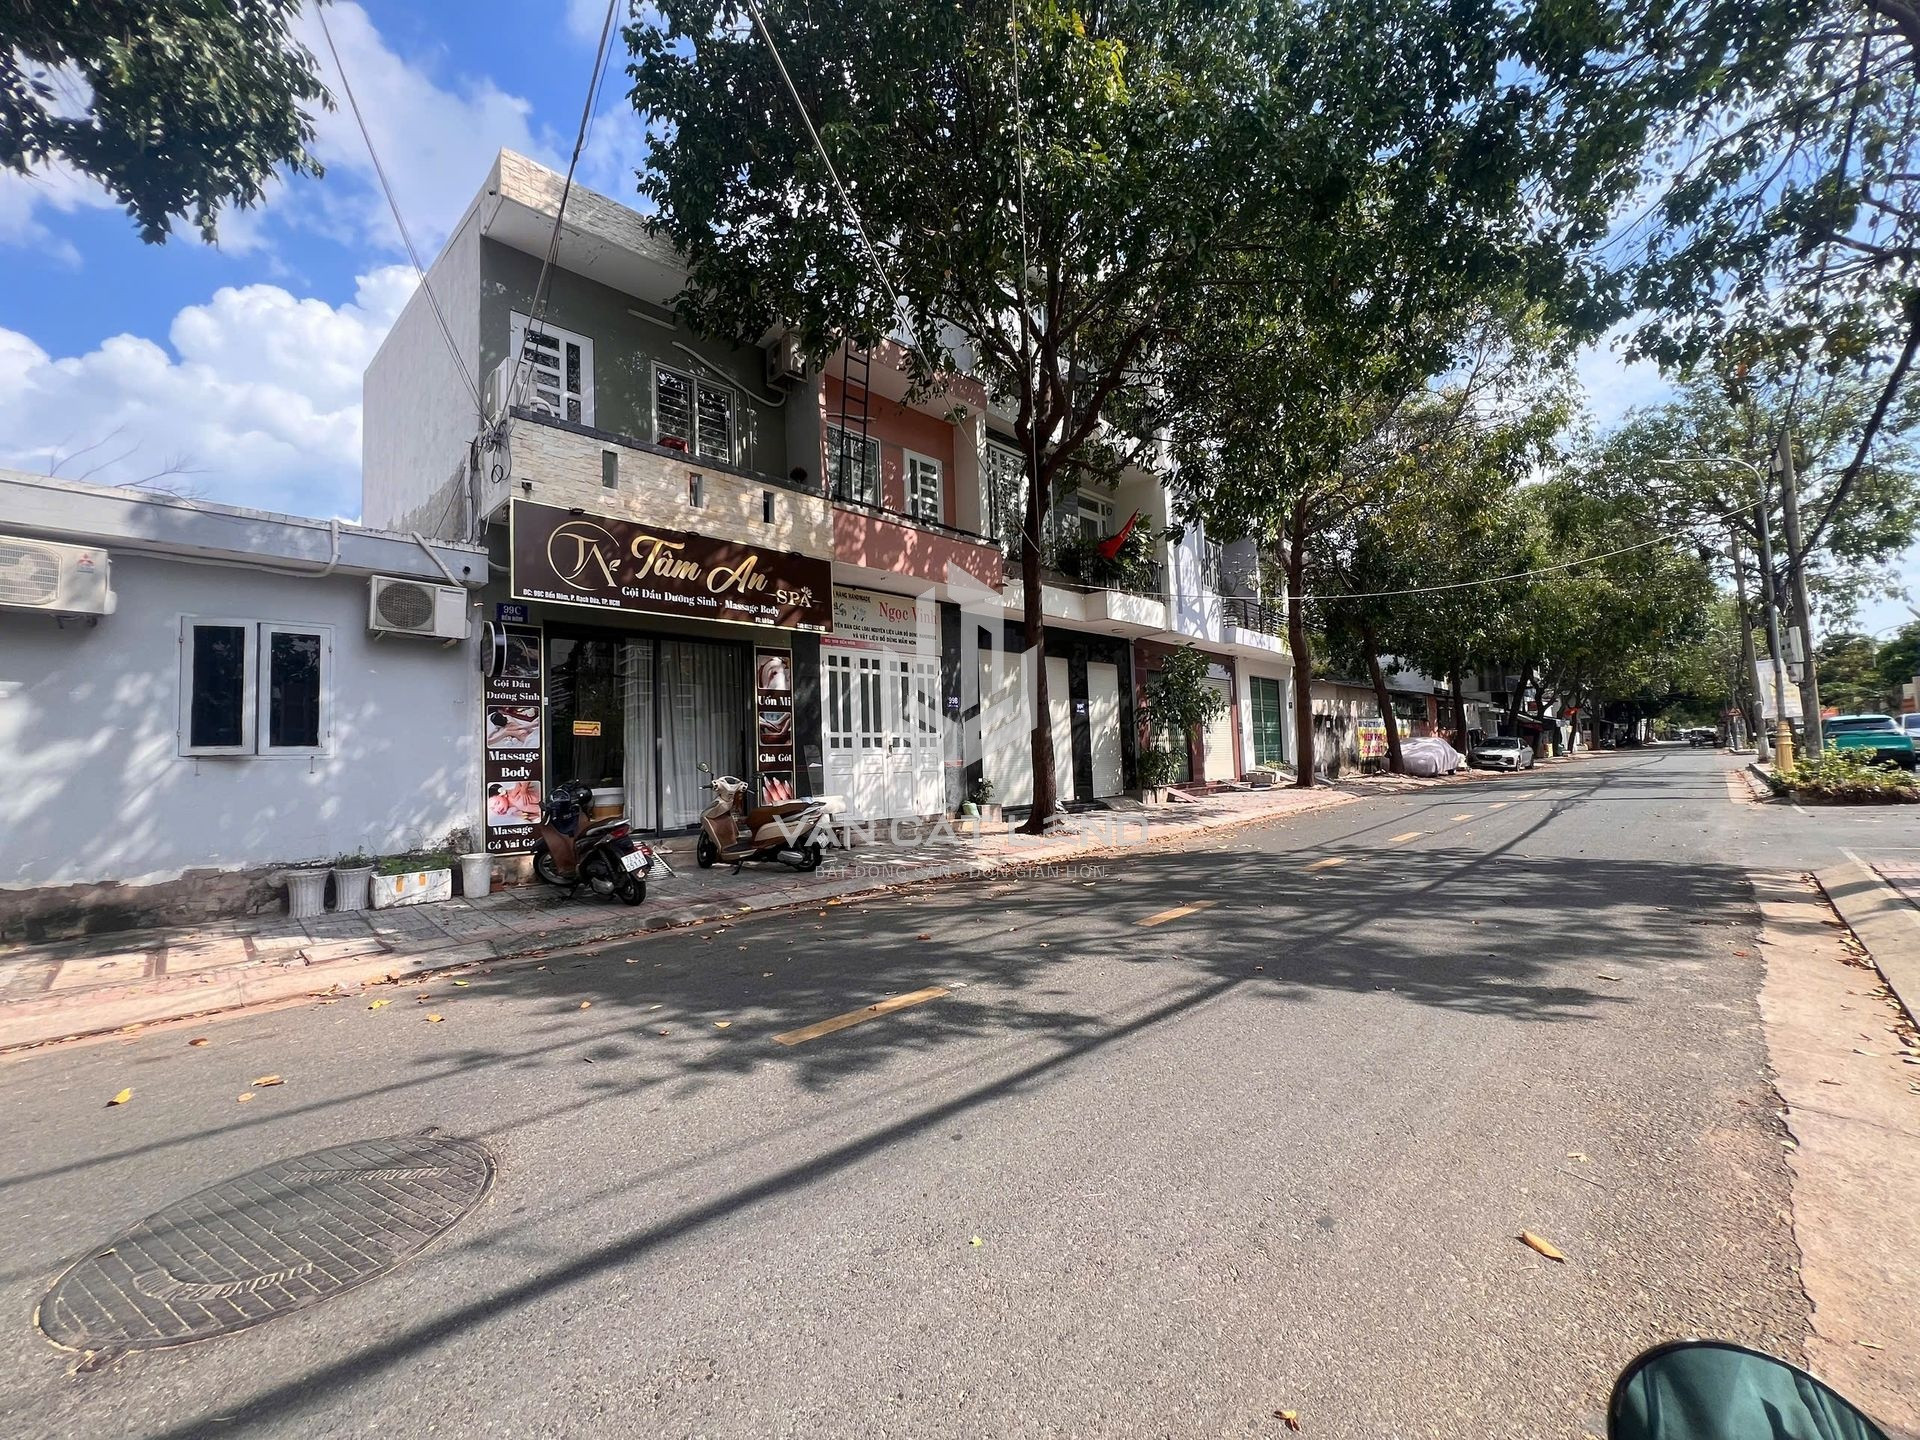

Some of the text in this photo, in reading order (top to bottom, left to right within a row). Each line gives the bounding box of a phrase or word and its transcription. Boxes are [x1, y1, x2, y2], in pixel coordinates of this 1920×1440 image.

[631, 535, 768, 594] Tâm An
[621, 586, 640, 598] Gội
[696, 596, 718, 607] Sinh
[724, 600, 759, 613] Massage
[760, 604, 780, 617] Body
[776, 588, 812, 608] SPA
[503, 605, 522, 616] 99C
[879, 601, 909, 624] Ngọc
[519, 692, 540, 700] Sinh
[488, 750, 540, 763] Massage
[777, 753, 792, 762] Gót
[501, 766, 532, 779] Body
[492, 825, 534, 836] Massage
[503, 839, 520, 849] Vai
